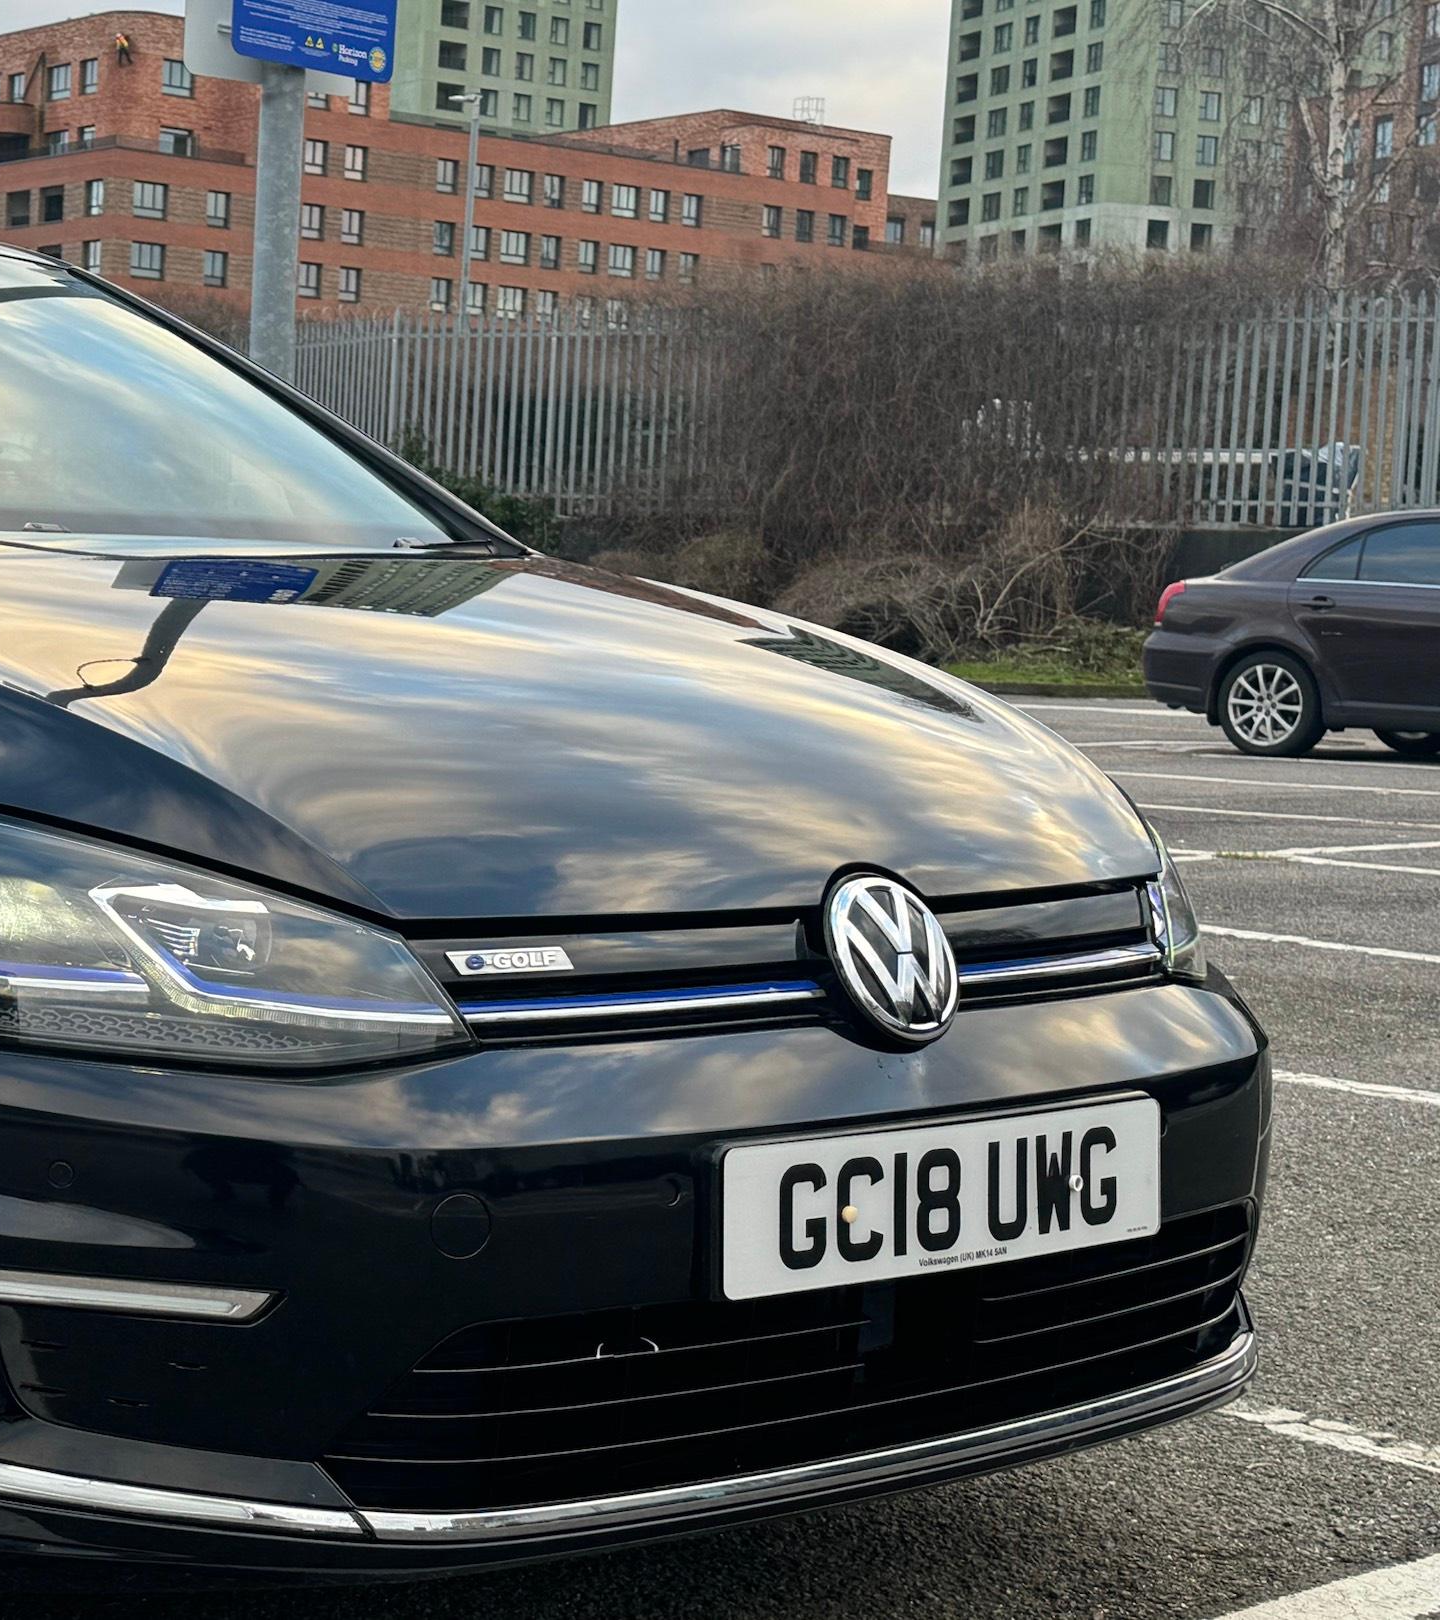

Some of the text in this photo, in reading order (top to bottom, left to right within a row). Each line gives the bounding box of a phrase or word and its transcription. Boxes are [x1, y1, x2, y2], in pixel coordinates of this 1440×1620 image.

[339, 44, 367, 59] Horizon
[779, 1126, 1117, 1270] GC18 UWG
[919, 1246, 1008, 1267] Volkswagen (UK) MK14 5AN
